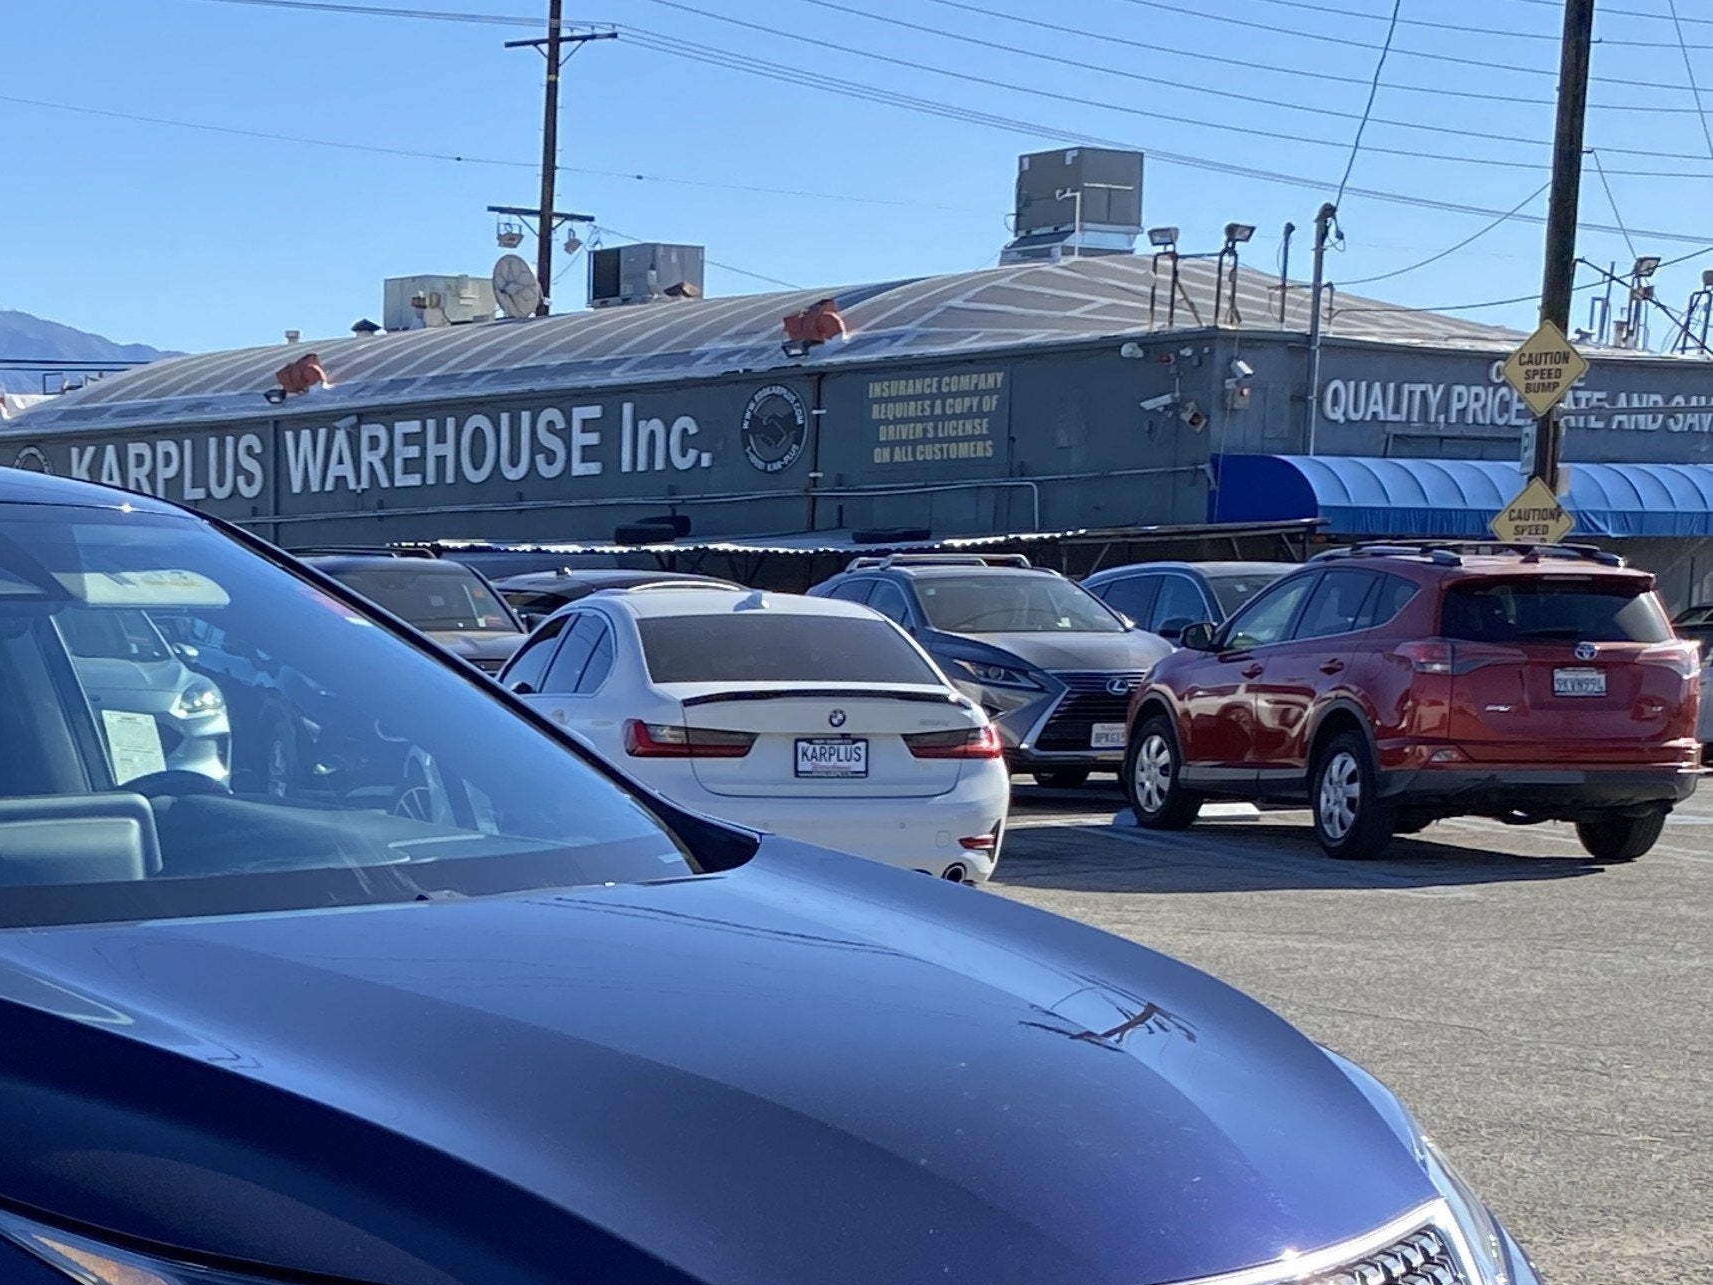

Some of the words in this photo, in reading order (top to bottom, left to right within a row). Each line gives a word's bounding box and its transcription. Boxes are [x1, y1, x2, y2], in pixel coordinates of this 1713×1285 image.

[1518, 351, 1571, 366] CAUTION
[1523, 368, 1562, 381] SPEED
[869, 377, 940, 398] INSURANCE
[941, 372, 1004, 392] COMPANY
[1524, 381, 1560, 394] BUMP
[872, 400, 931, 420] REQUIRES
[933, 399, 942, 415] A
[945, 396, 980, 415] COPY
[982, 394, 999, 412] OF
[1323, 379, 1445, 430] QUALITY,
[1612, 393, 1664, 431] AND
[879, 421, 934, 441] DRIVER'S
[937, 418, 990, 438] LICENSE
[70, 433, 263, 500] KARPLUS
[285, 404, 604, 493] WAREHOUSE
[620, 402, 713, 473] Inc.
[873, 446, 891, 463] ON
[893, 445, 914, 462] ALL
[916, 440, 993, 461] CUSTOMERS
[1508, 507, 1558, 522] CAUTION
[1513, 525, 1549, 536] SPEED
[800, 745, 862, 763] KARPLUS
